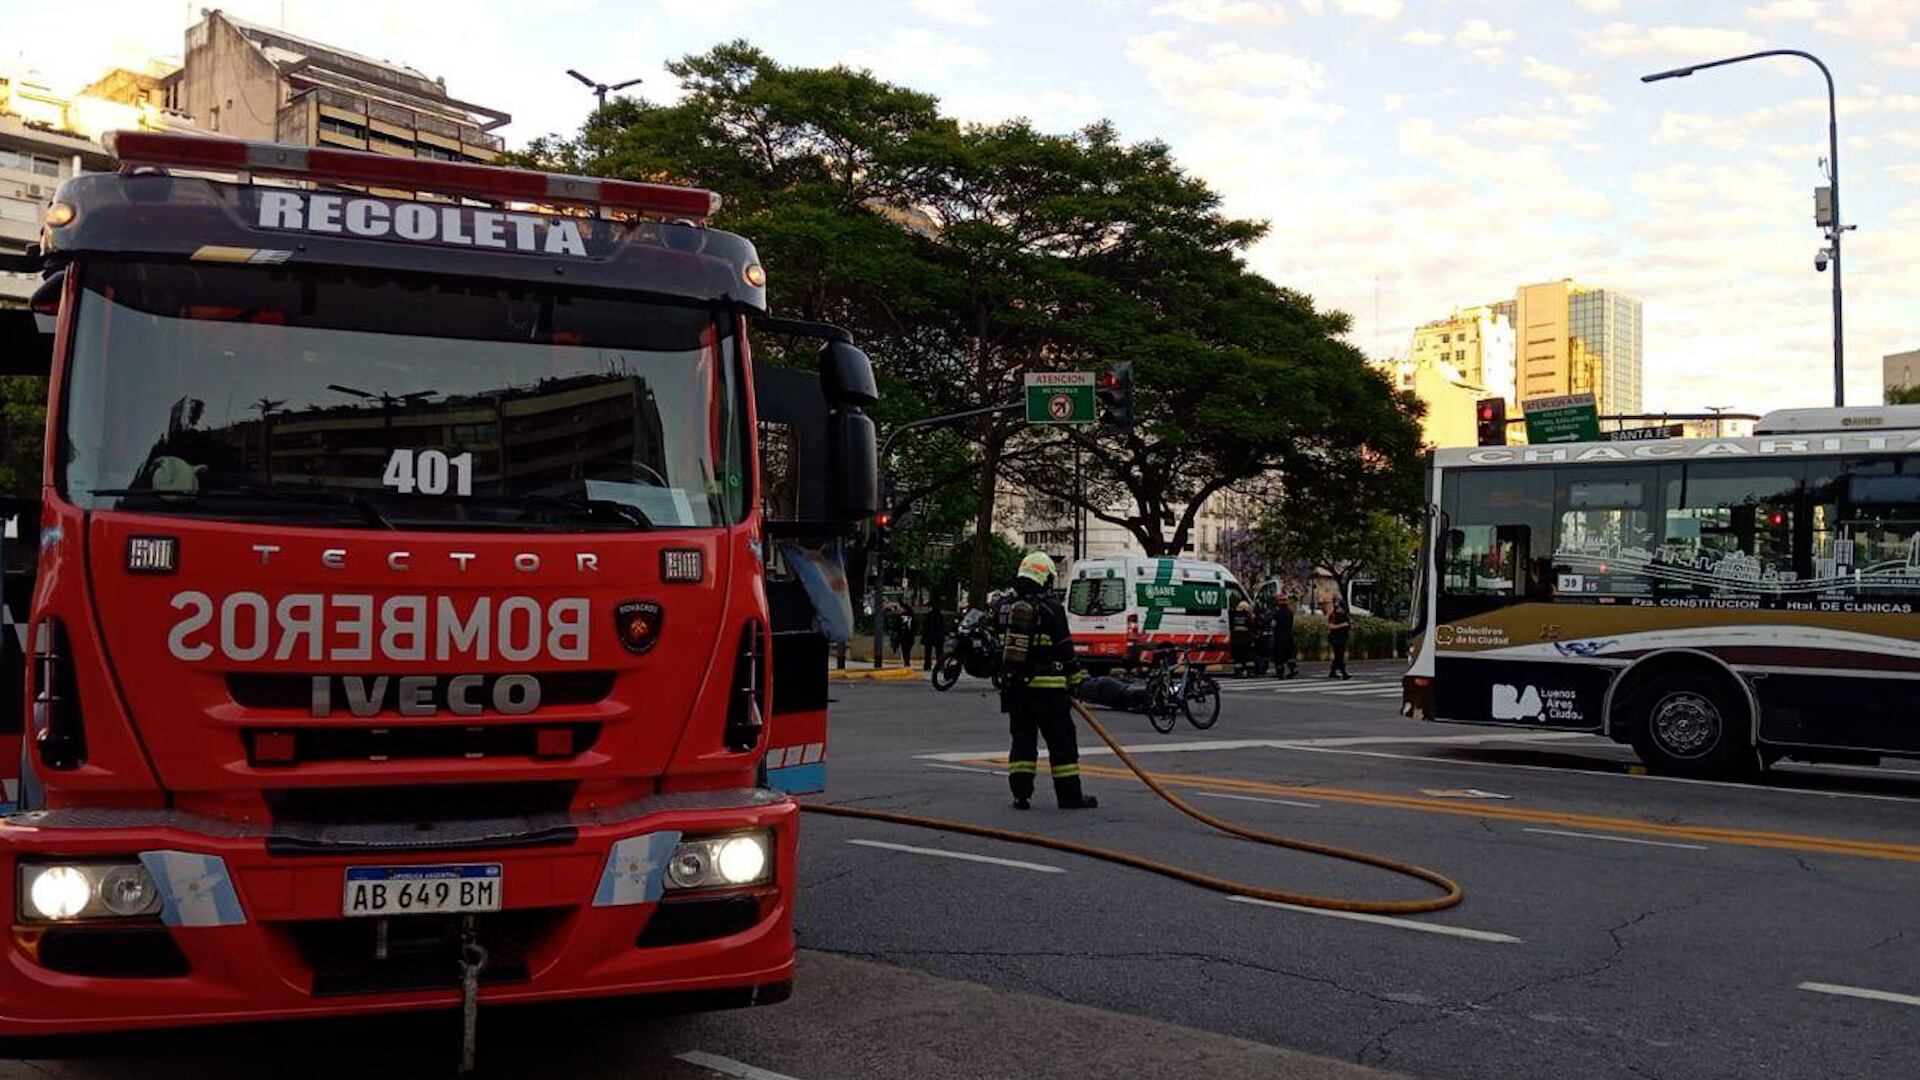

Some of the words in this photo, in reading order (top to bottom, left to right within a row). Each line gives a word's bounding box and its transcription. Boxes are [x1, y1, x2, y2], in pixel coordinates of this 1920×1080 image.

[258, 191, 588, 257] RECOLETA
[1611, 428, 1653, 442] SANTA
[1655, 426, 1672, 439] FE
[382, 448, 473, 496] 401
[252, 545, 599, 572] TECTOR
[1200, 590, 1218, 606] 107
[1631, 598, 1657, 608] Pza.
[1659, 598, 1760, 609] CONSTITUCION
[1821, 601, 1840, 612] DE
[1844, 602, 1912, 613] CLINICAS
[1455, 626, 1504, 636] Colectivos
[1477, 636, 1509, 646] Ciudad
[311, 673, 542, 718] IVECO
[1546, 698, 1573, 709] Aires
[353, 883, 387, 911] AB
[399, 882, 449, 909] 649
[460, 880, 493, 907] BM
